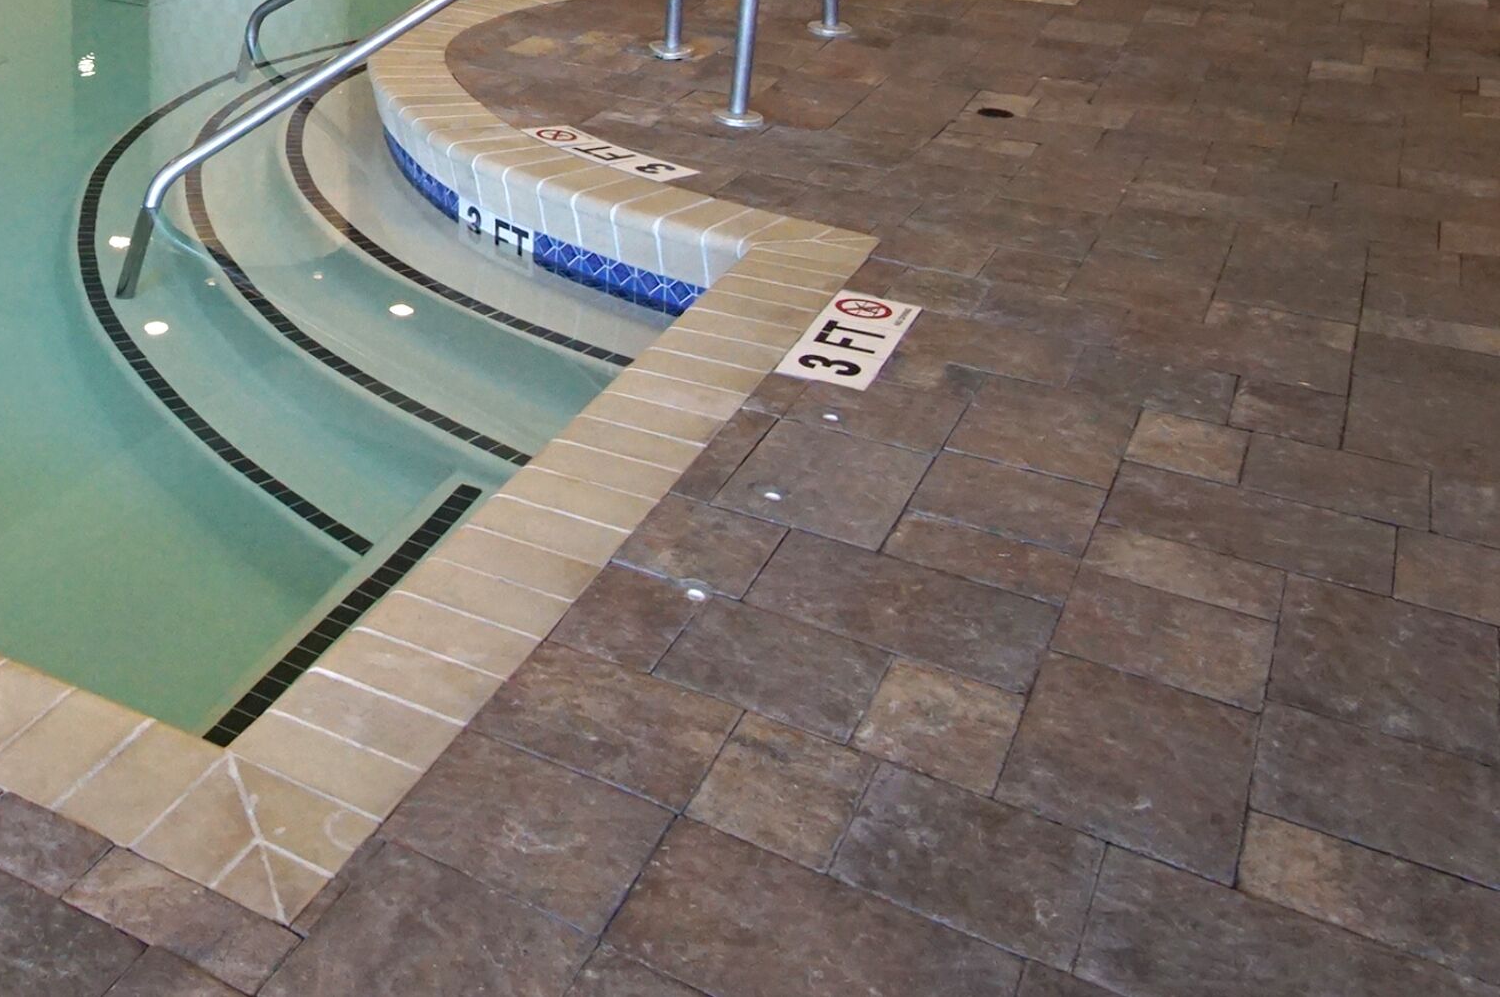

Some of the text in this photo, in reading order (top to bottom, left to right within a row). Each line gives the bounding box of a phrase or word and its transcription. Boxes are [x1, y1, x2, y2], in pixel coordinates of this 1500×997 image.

[573, 145, 676, 175] 3 FT
[494, 219, 530, 256] FT
[798, 319, 886, 376] 3 FT
